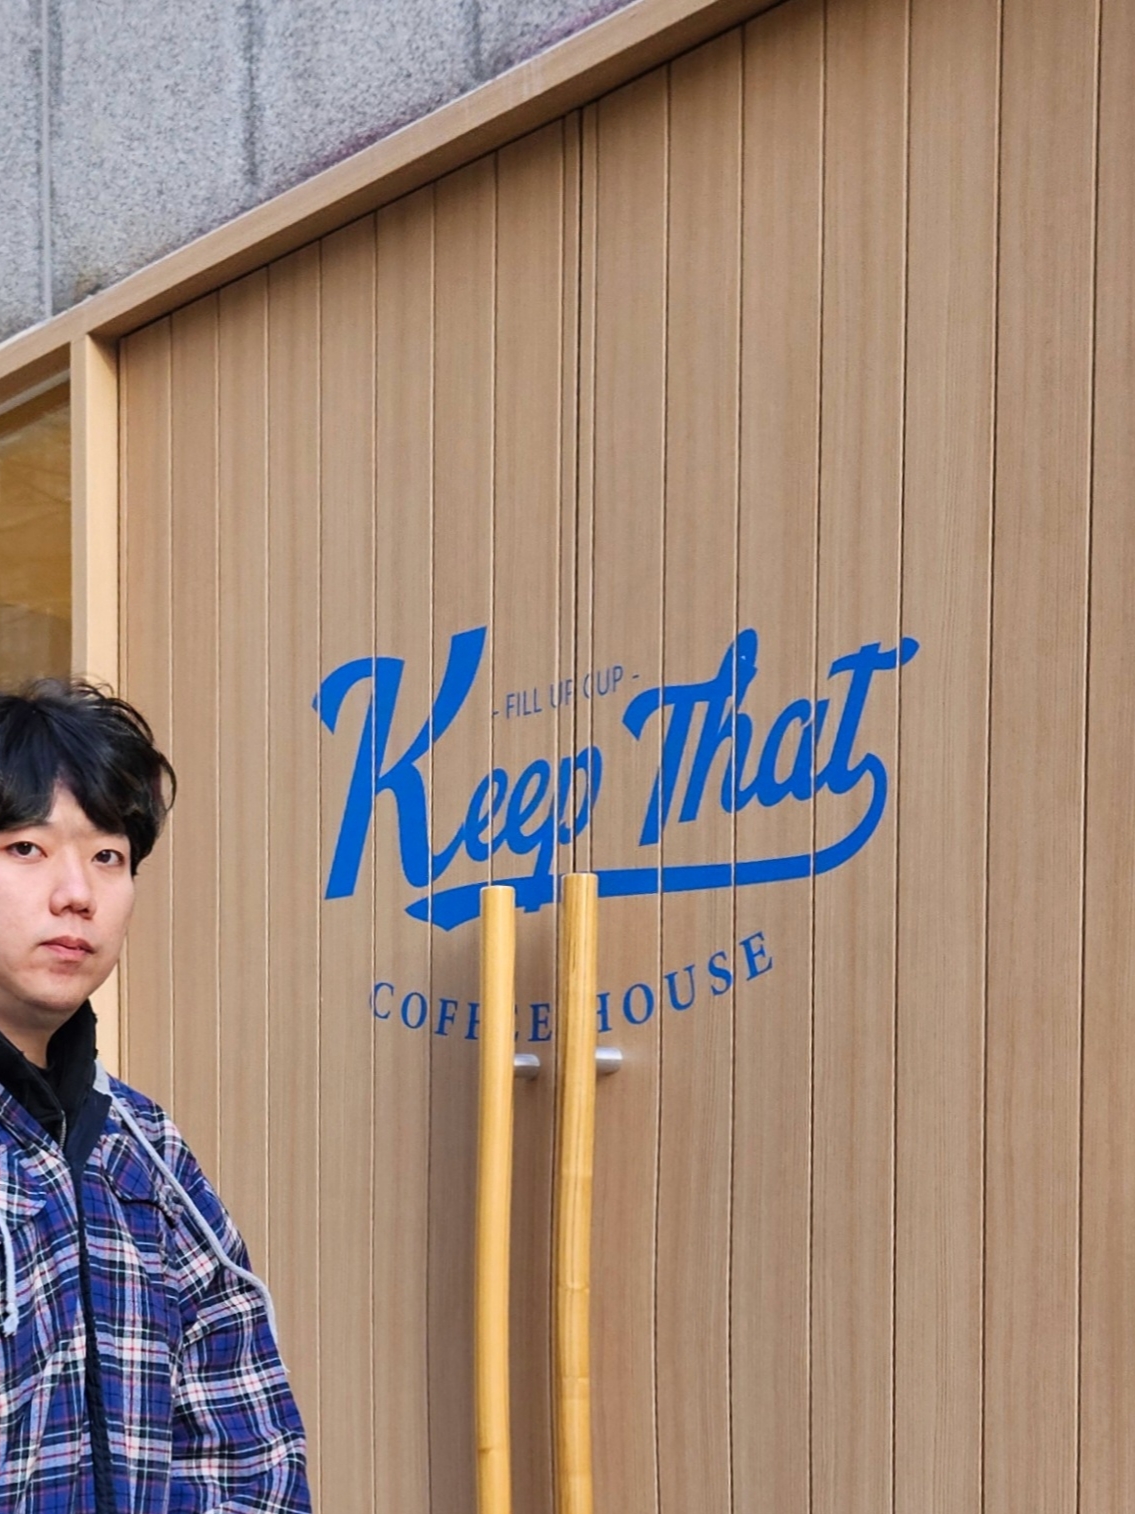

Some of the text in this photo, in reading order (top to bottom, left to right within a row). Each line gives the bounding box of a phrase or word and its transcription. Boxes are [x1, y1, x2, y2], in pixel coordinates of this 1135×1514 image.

[505, 688, 542, 719] FILL
[312, 626, 920, 912] Keep That
[369, 982, 553, 1043] COFFE
